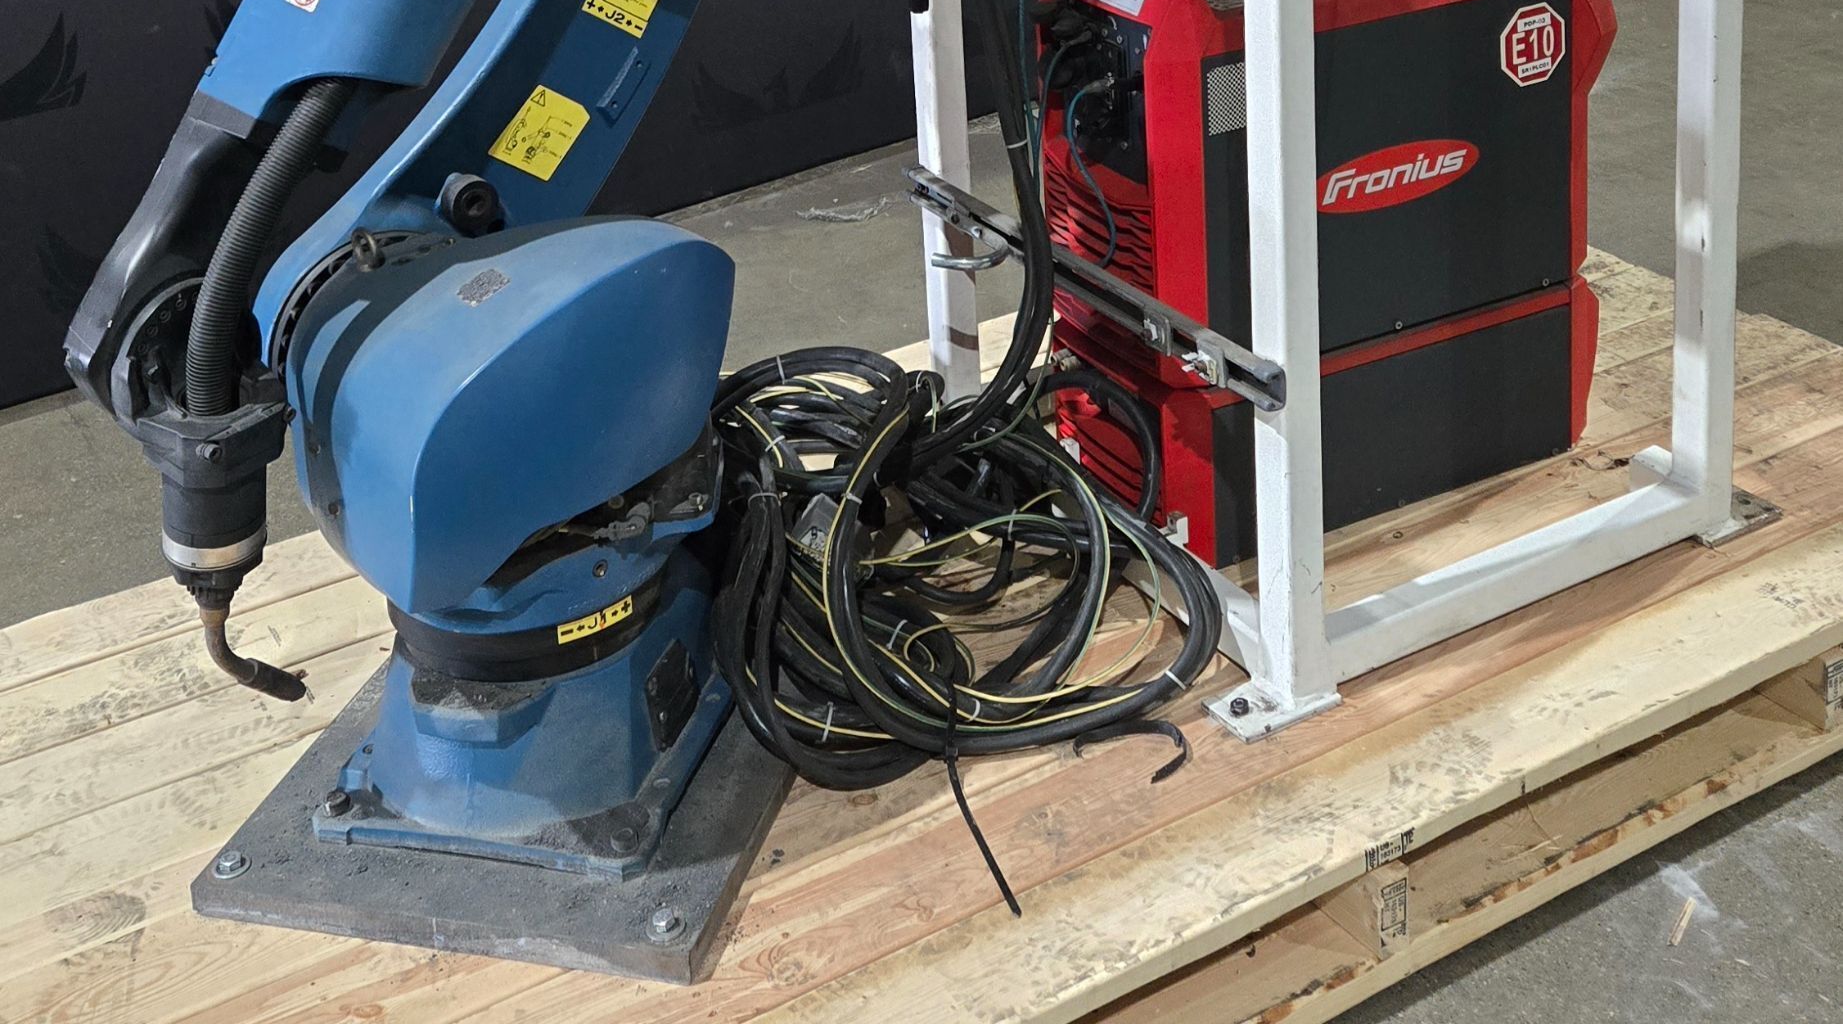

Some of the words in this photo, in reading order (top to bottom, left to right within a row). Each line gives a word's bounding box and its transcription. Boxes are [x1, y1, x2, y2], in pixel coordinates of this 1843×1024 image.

[605, 10, 626, 25] J2
[1512, 25, 1555, 65] E10
[1322, 148, 1468, 206] Fronius
